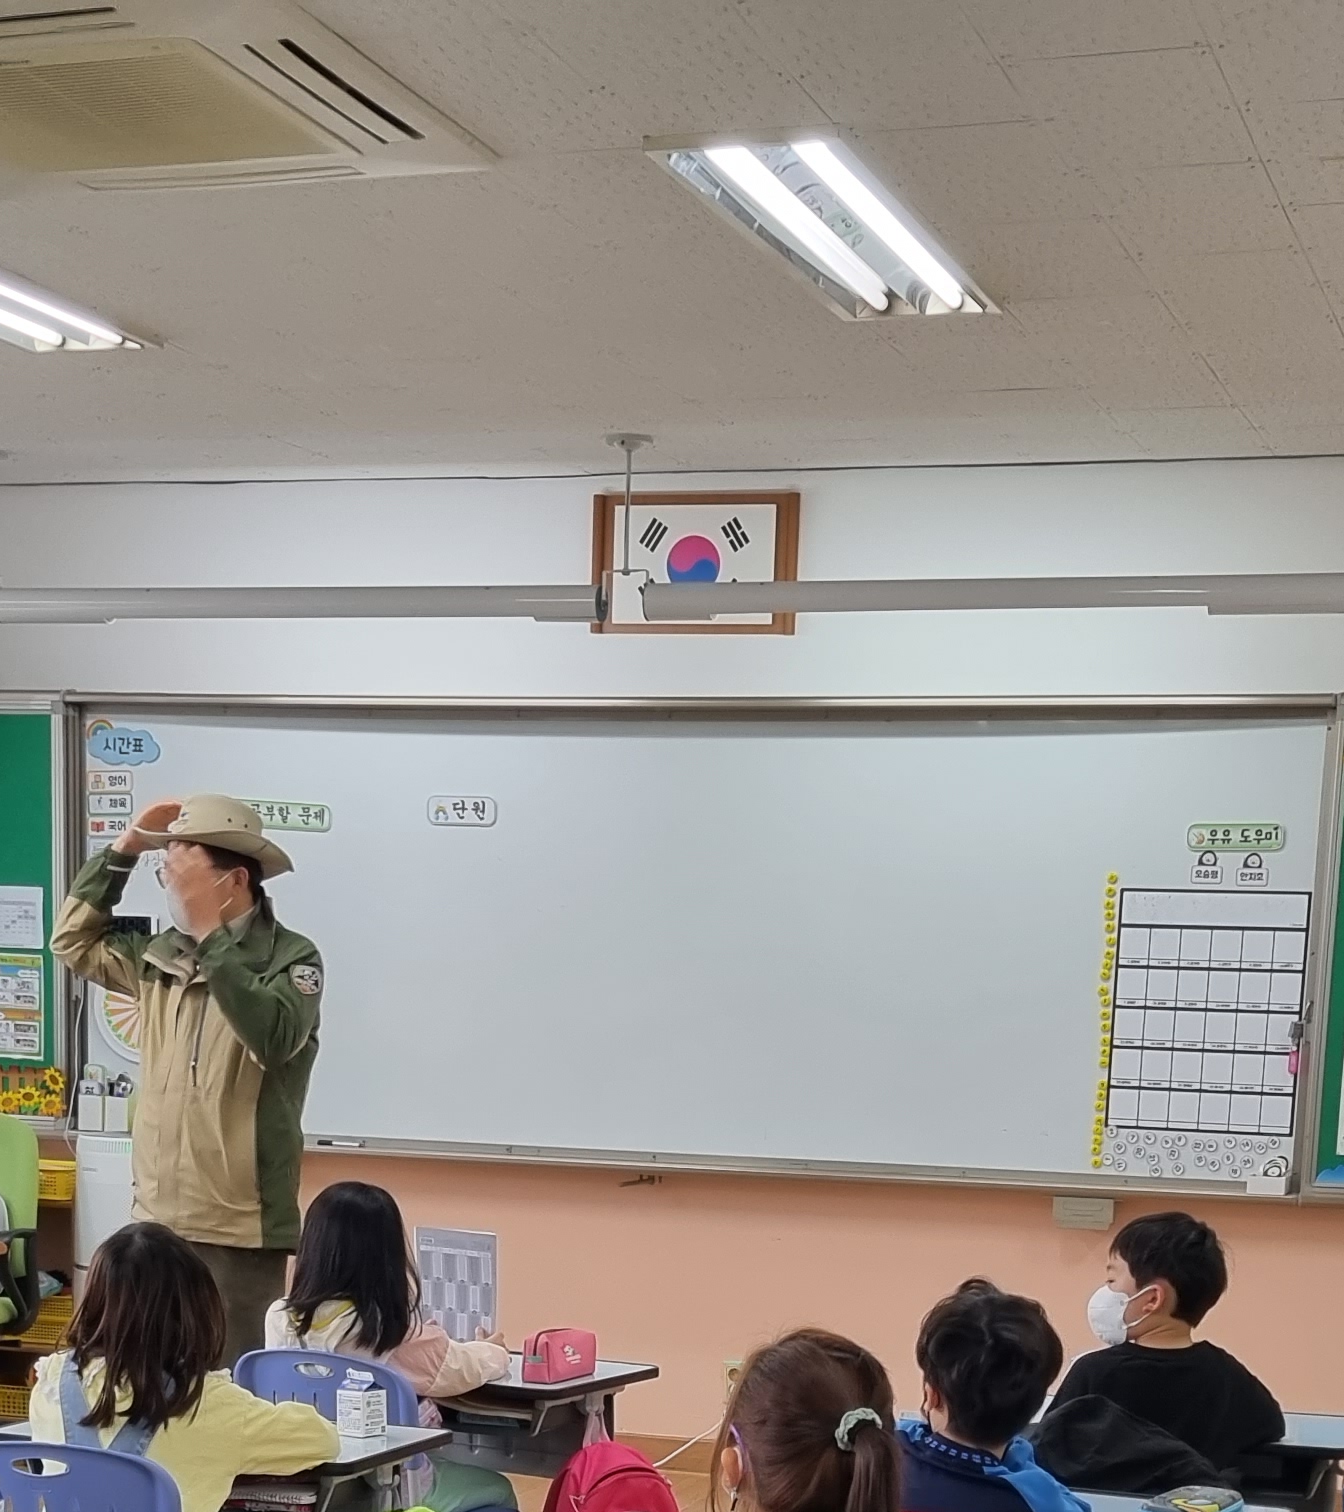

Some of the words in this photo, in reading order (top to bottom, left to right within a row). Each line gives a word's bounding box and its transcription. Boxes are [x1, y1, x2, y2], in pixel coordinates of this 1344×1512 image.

[103, 737, 144, 755] 시간표
[107, 775, 127, 787] 영어
[298, 806, 325, 826] 문제
[452, 800, 486, 821] 단원
[108, 820, 127, 832] 국어
[1207, 829, 1232, 845] 우유
[1239, 826, 1279, 845] 도우미
